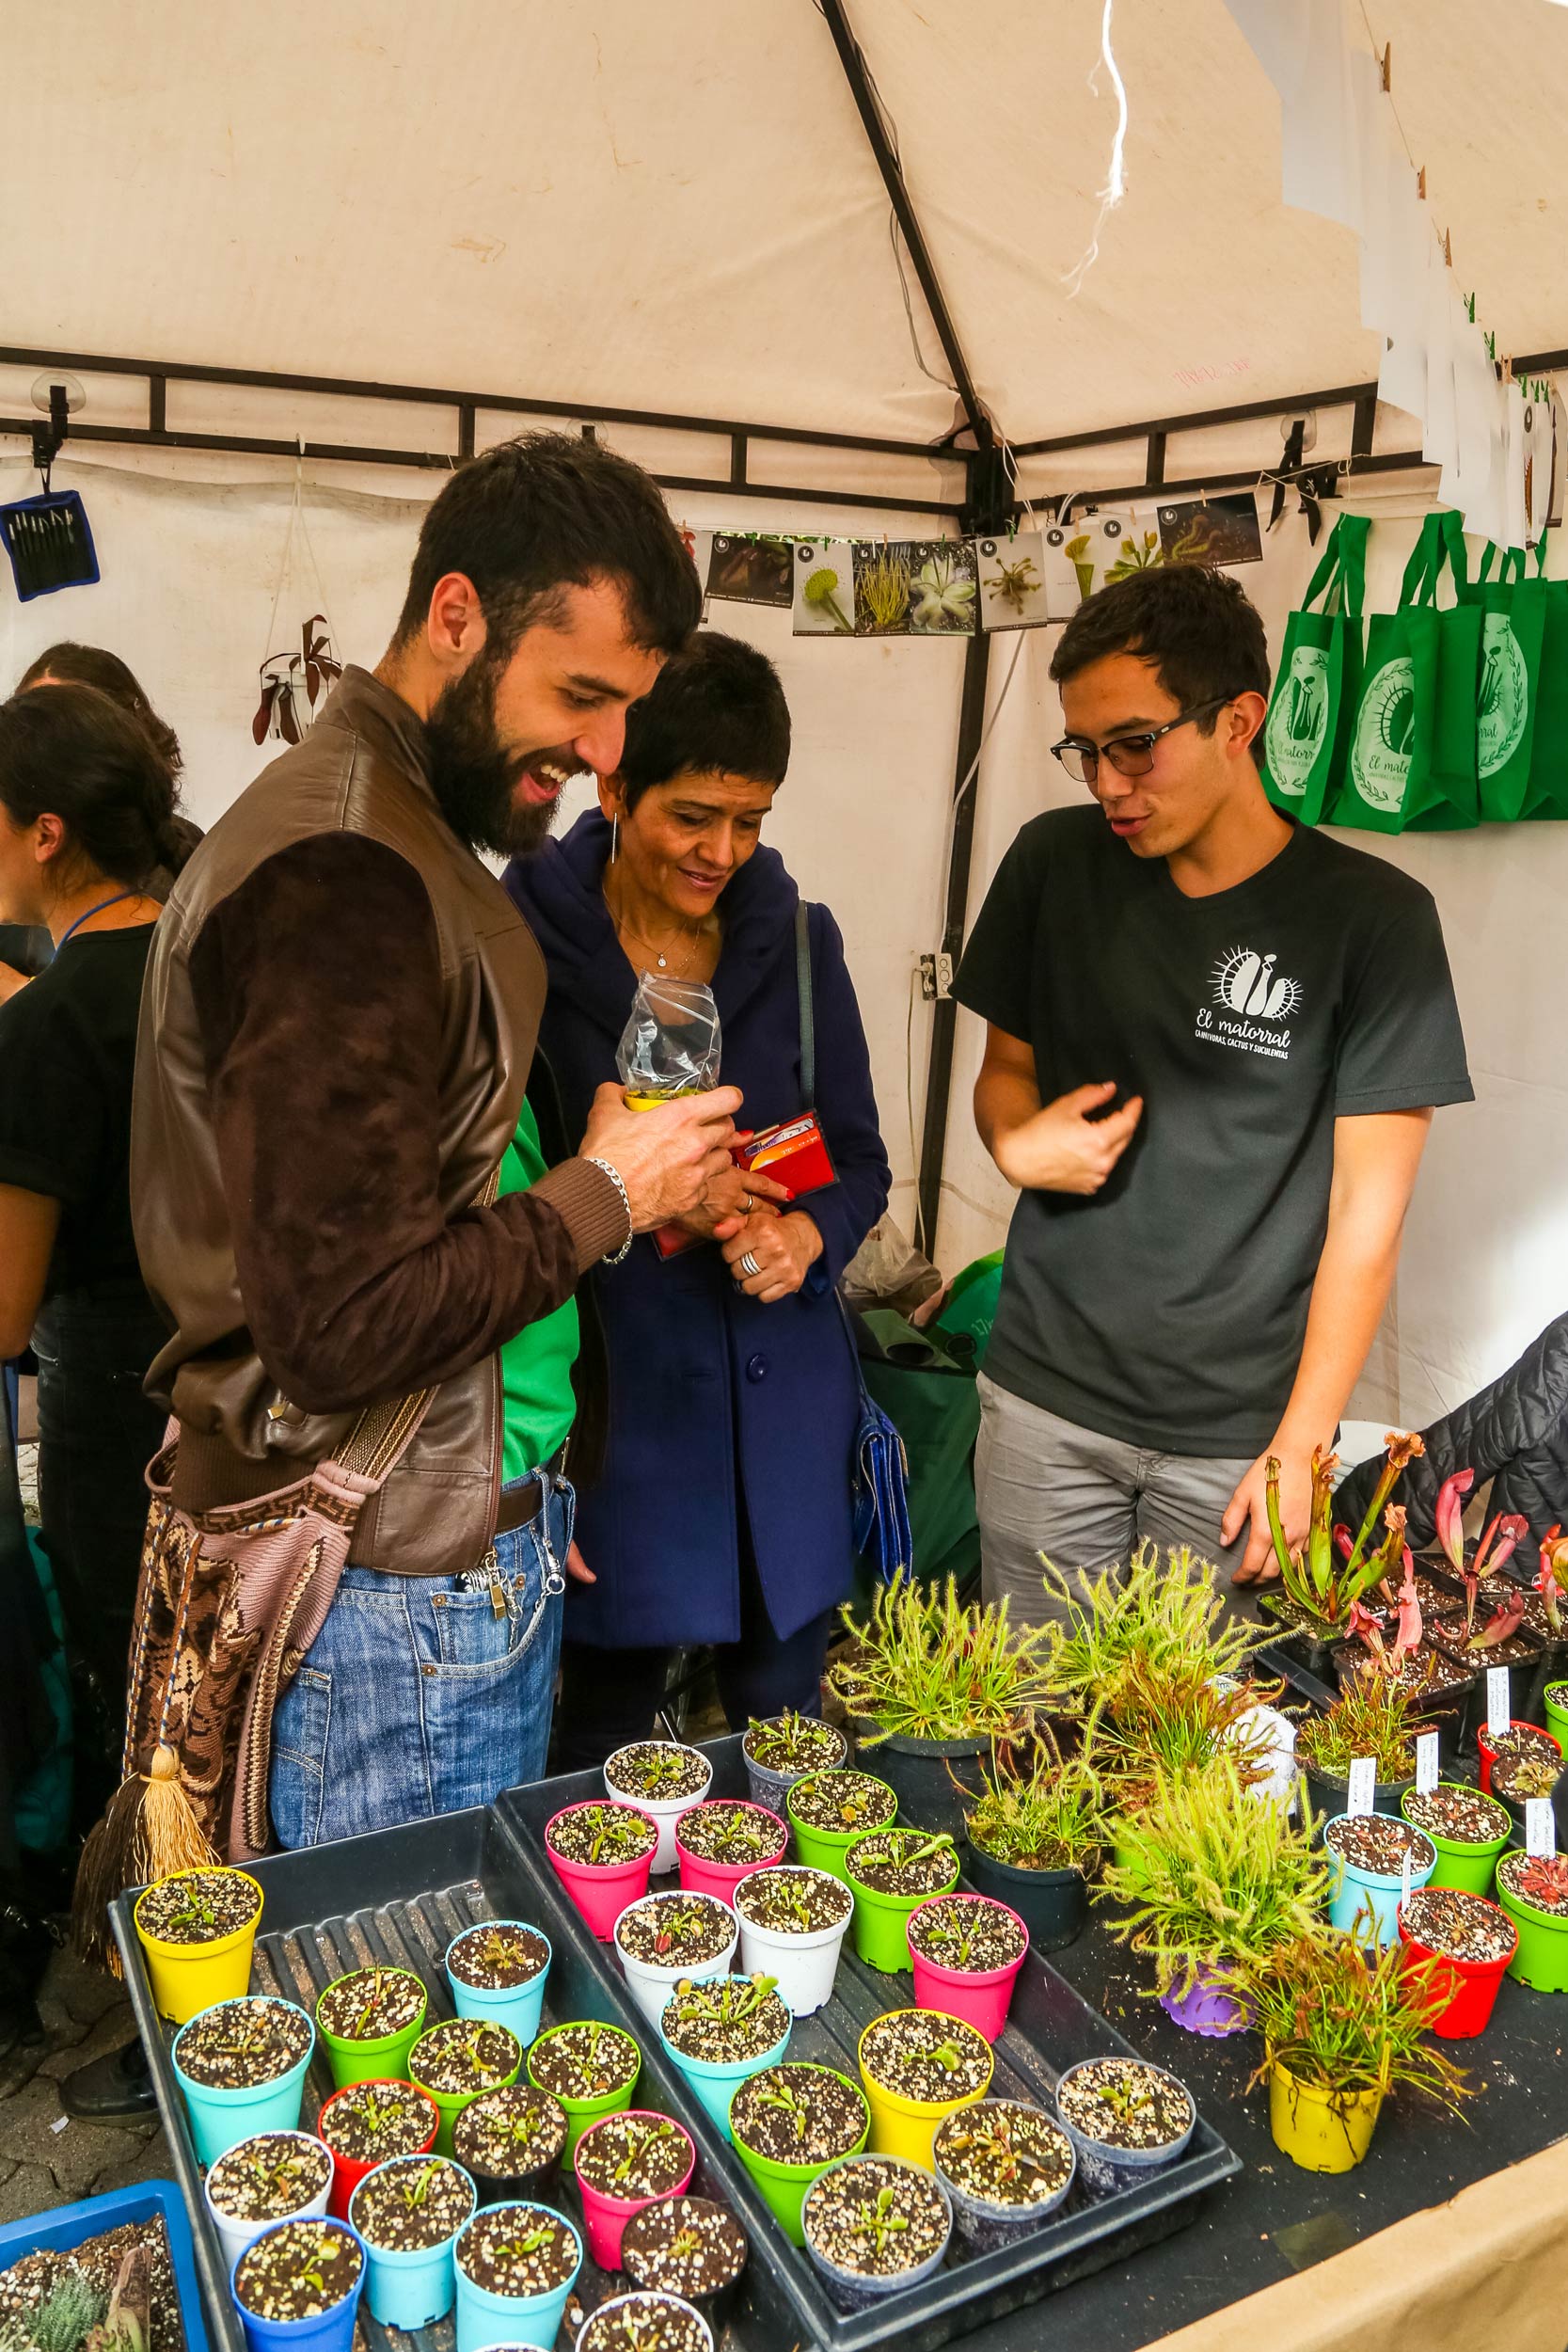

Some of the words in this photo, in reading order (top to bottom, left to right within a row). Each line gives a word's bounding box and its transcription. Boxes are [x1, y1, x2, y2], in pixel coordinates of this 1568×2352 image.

[1369, 755, 1381, 770] El
[1196, 1008, 1213, 1029] El
[1218, 1019, 1291, 1048] matorral
[1227, 1038, 1249, 1050] CACTUS
[1253, 1044, 1289, 1060] SUCULENTAS
